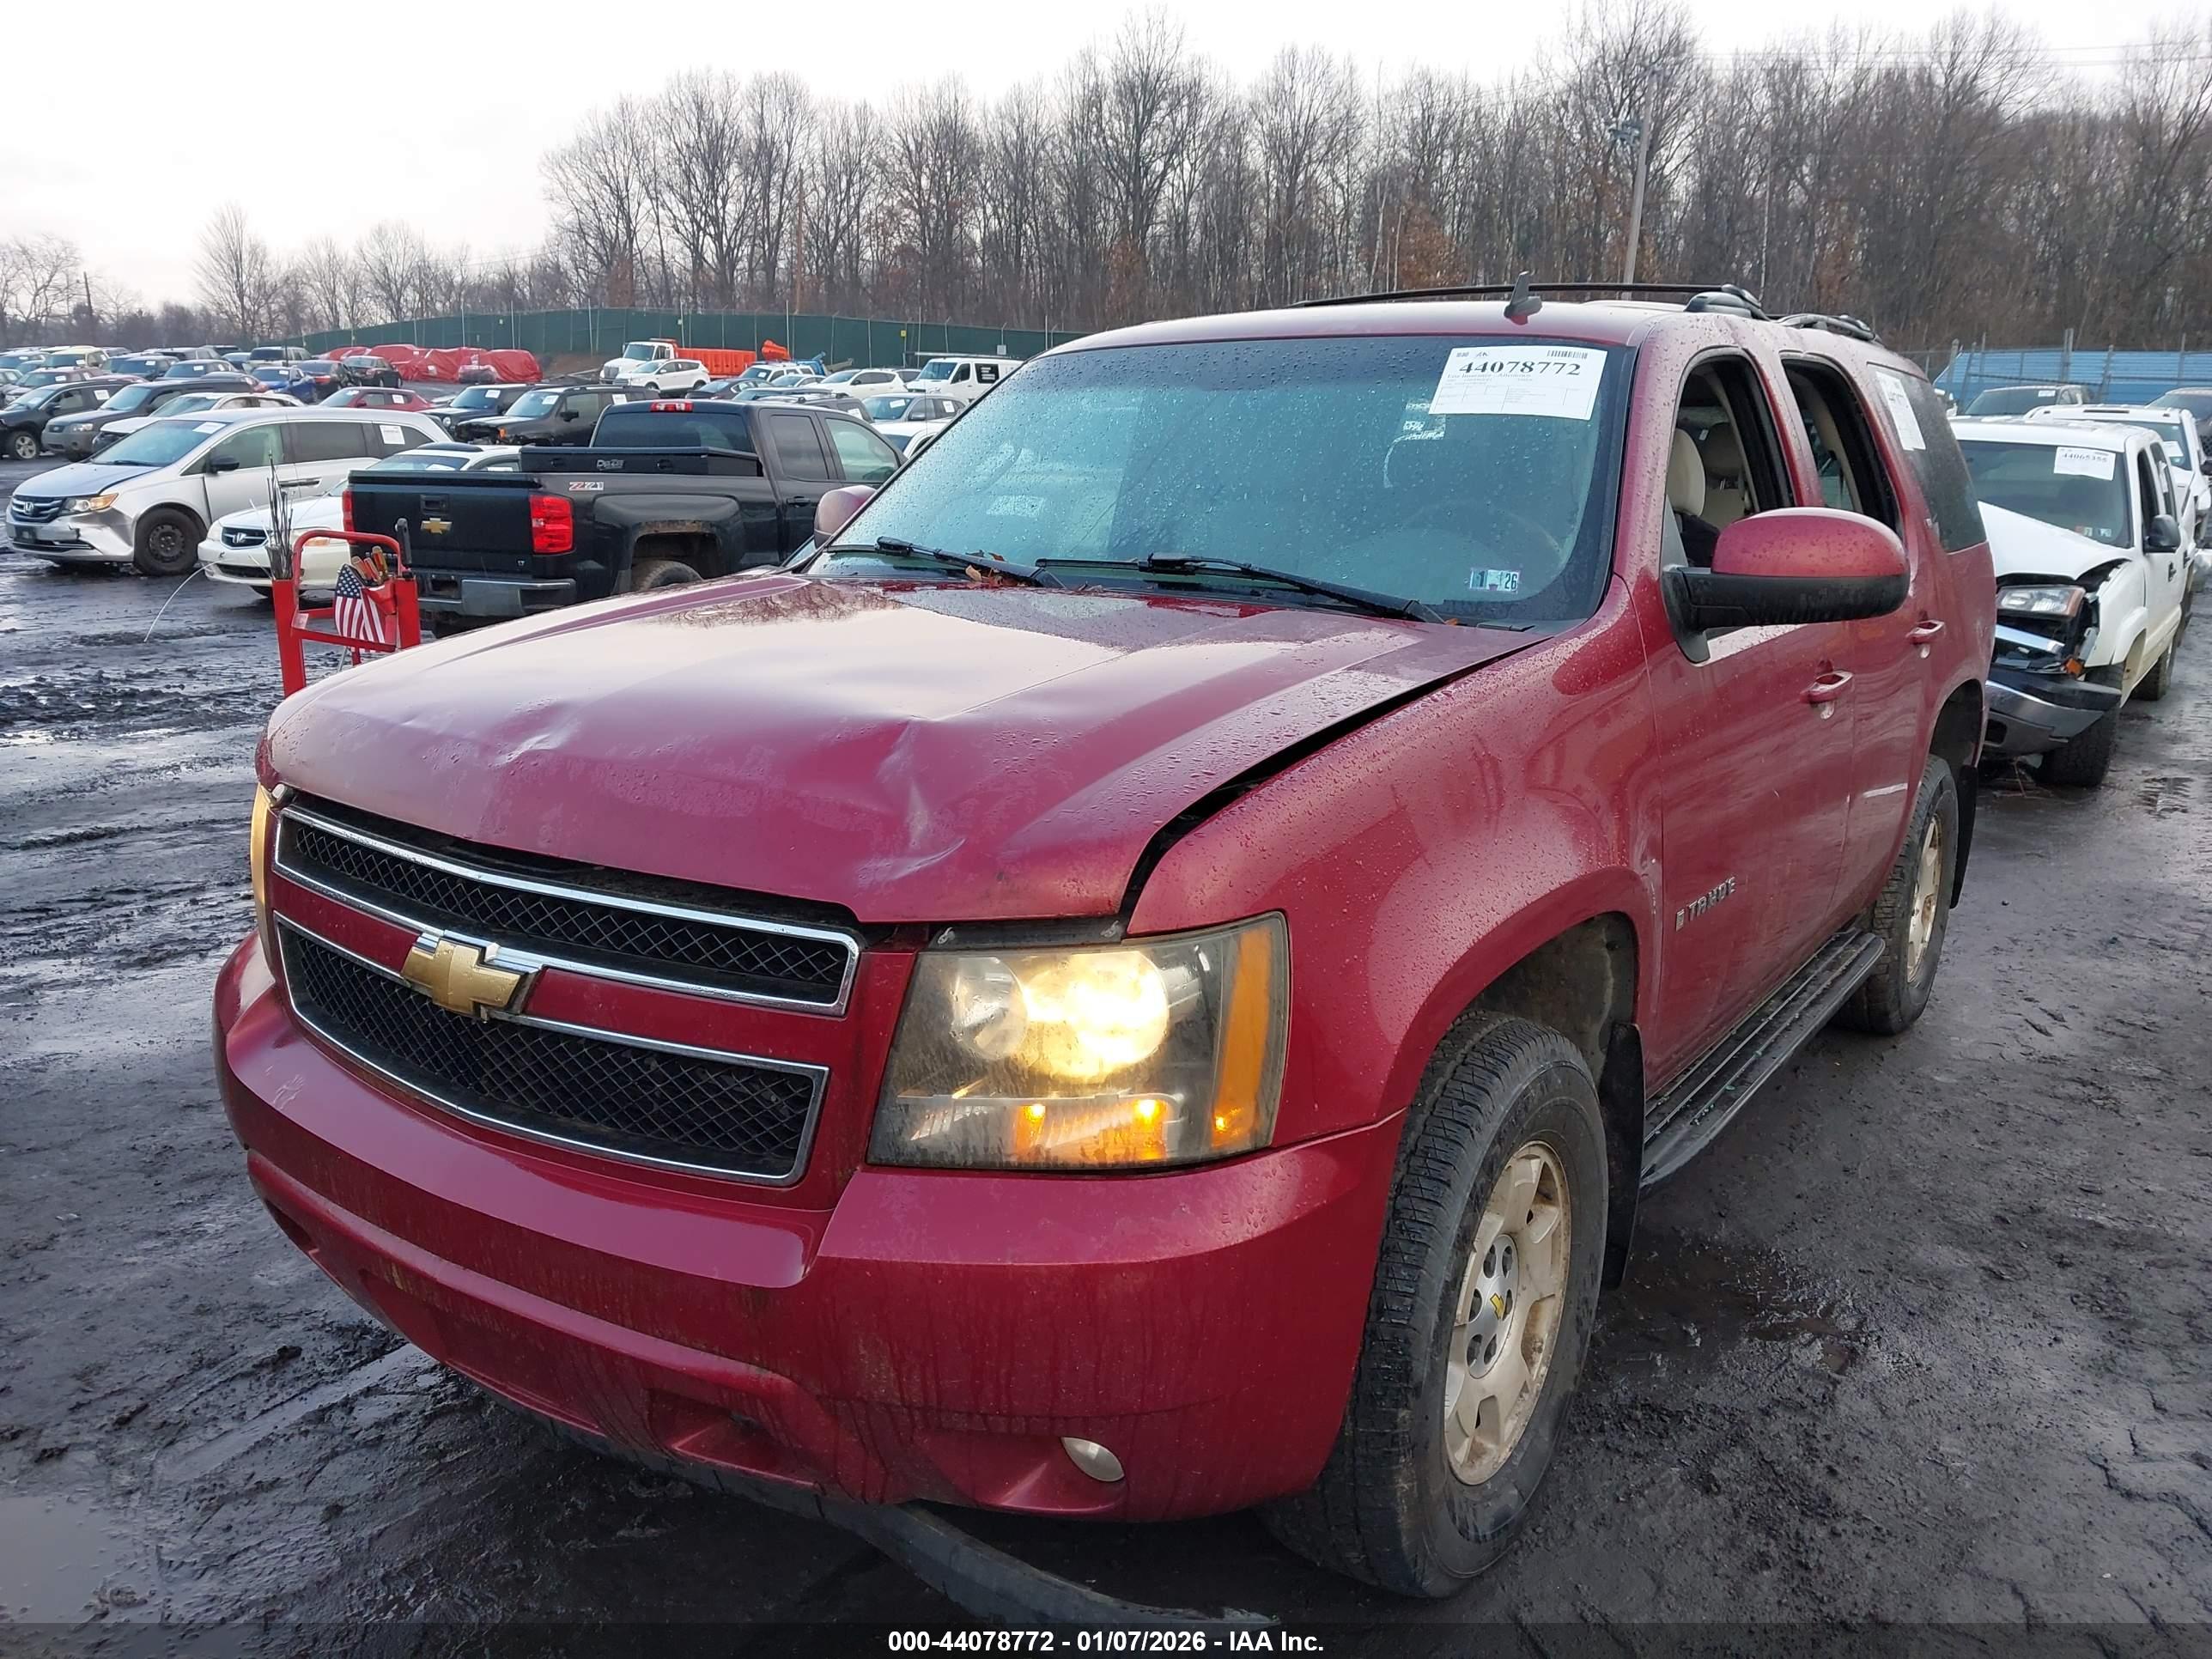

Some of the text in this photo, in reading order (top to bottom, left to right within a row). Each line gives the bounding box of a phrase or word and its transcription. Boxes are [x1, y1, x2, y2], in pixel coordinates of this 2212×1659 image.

[1459, 362, 1581, 375] 44078772
[1504, 573, 1518, 590] 26
[1687, 876, 1735, 921] TAHOE
